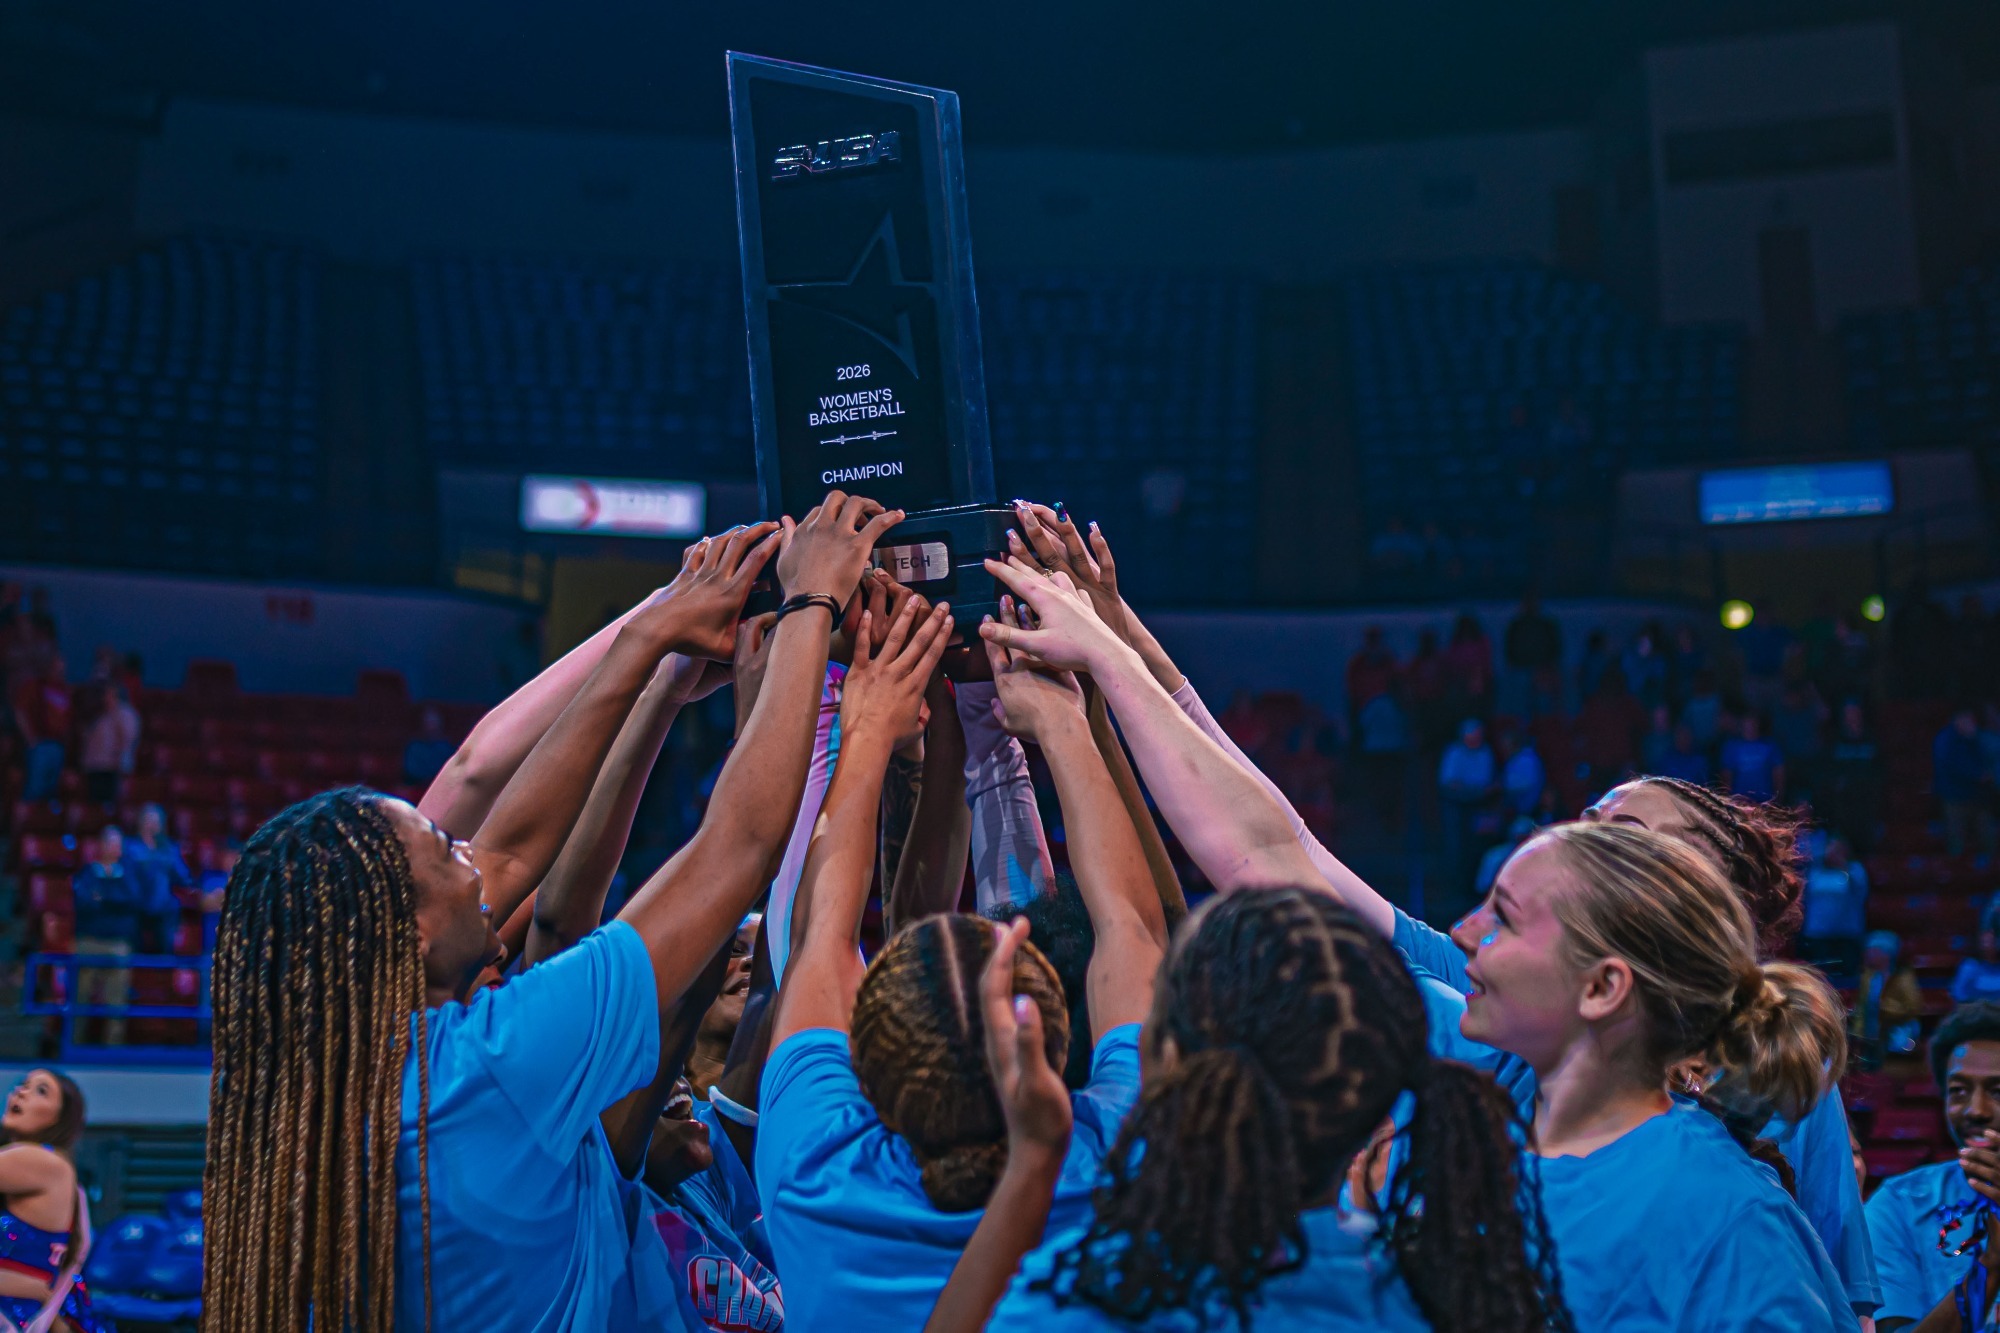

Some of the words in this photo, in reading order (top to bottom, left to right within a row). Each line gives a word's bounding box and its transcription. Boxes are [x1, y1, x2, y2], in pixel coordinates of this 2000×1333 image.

[837, 364, 871, 381] 2026
[819, 388, 893, 410] WOMEN'S
[809, 402, 906, 426] BASKETBALL
[822, 461, 903, 484] CHAMPION
[892, 554, 931, 570] TECH
